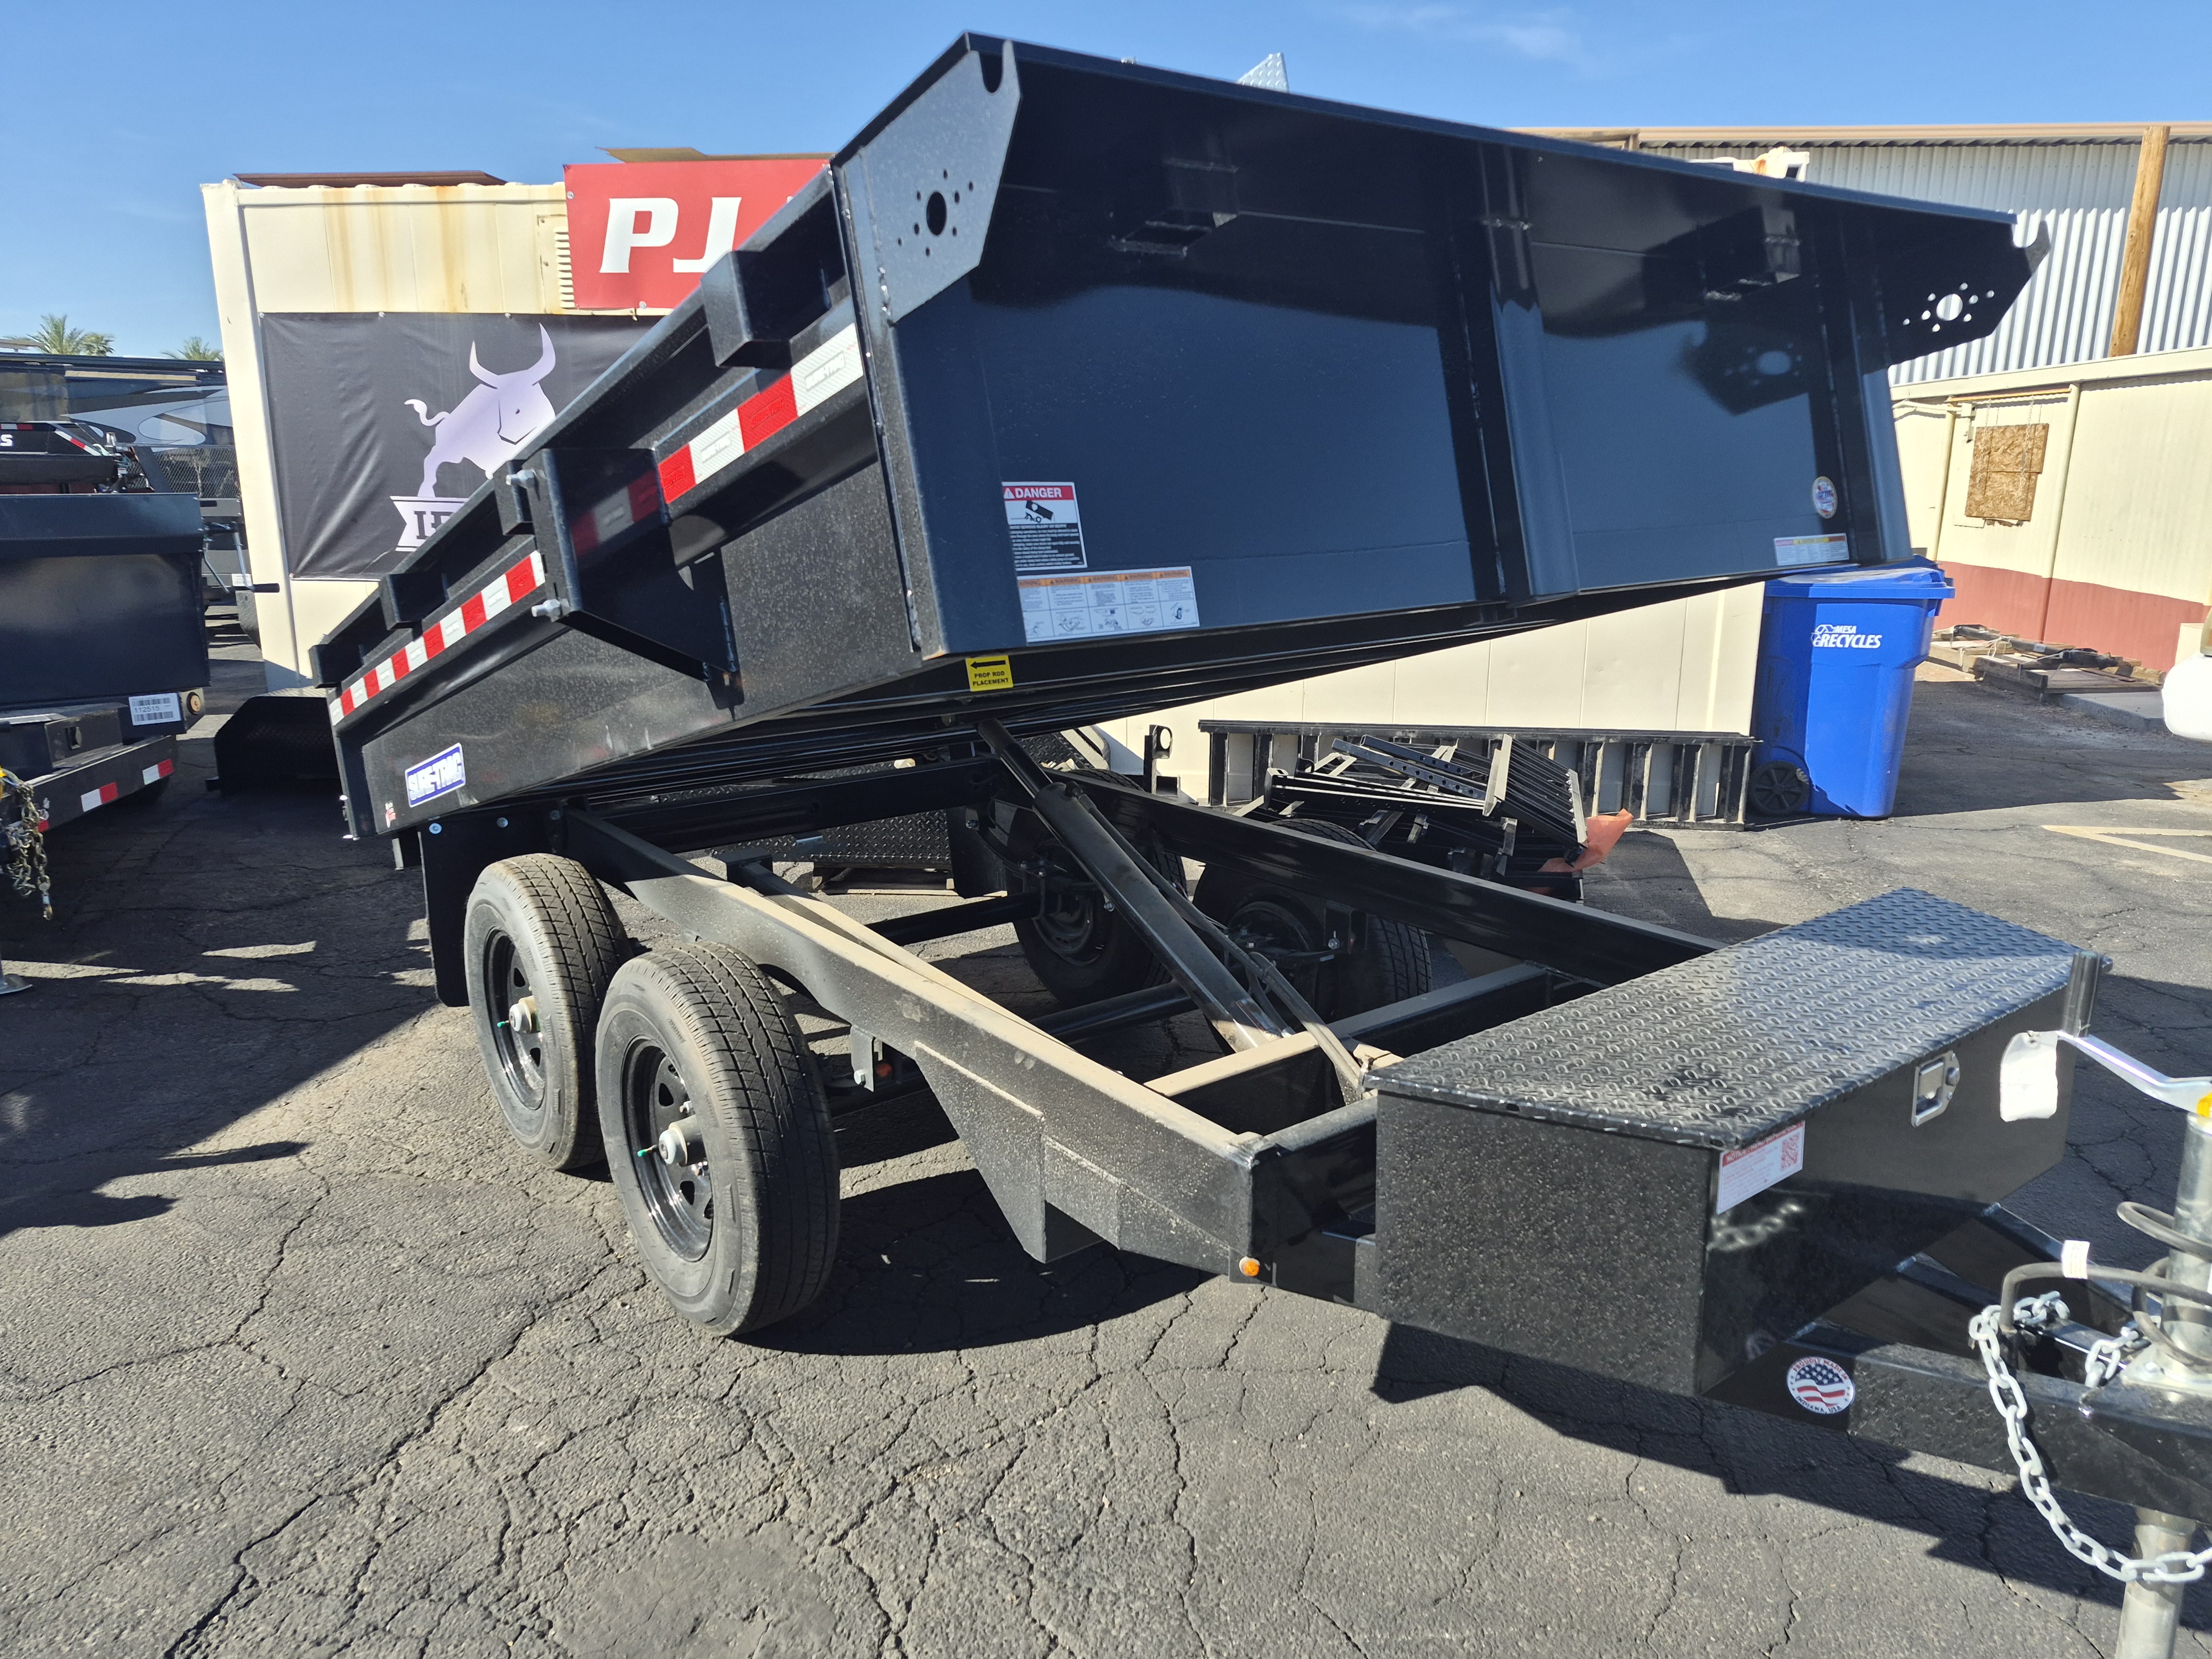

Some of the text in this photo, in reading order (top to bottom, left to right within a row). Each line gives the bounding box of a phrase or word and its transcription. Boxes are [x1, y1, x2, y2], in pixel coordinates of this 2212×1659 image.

[599, 197, 742, 273] PJ
[1015, 488, 1062, 498] DANGER
[1820, 634, 1882, 648] RECYCLES
[1792, 1357, 1820, 1371] PROUDLY
[1824, 1360, 1842, 1373] MADE
